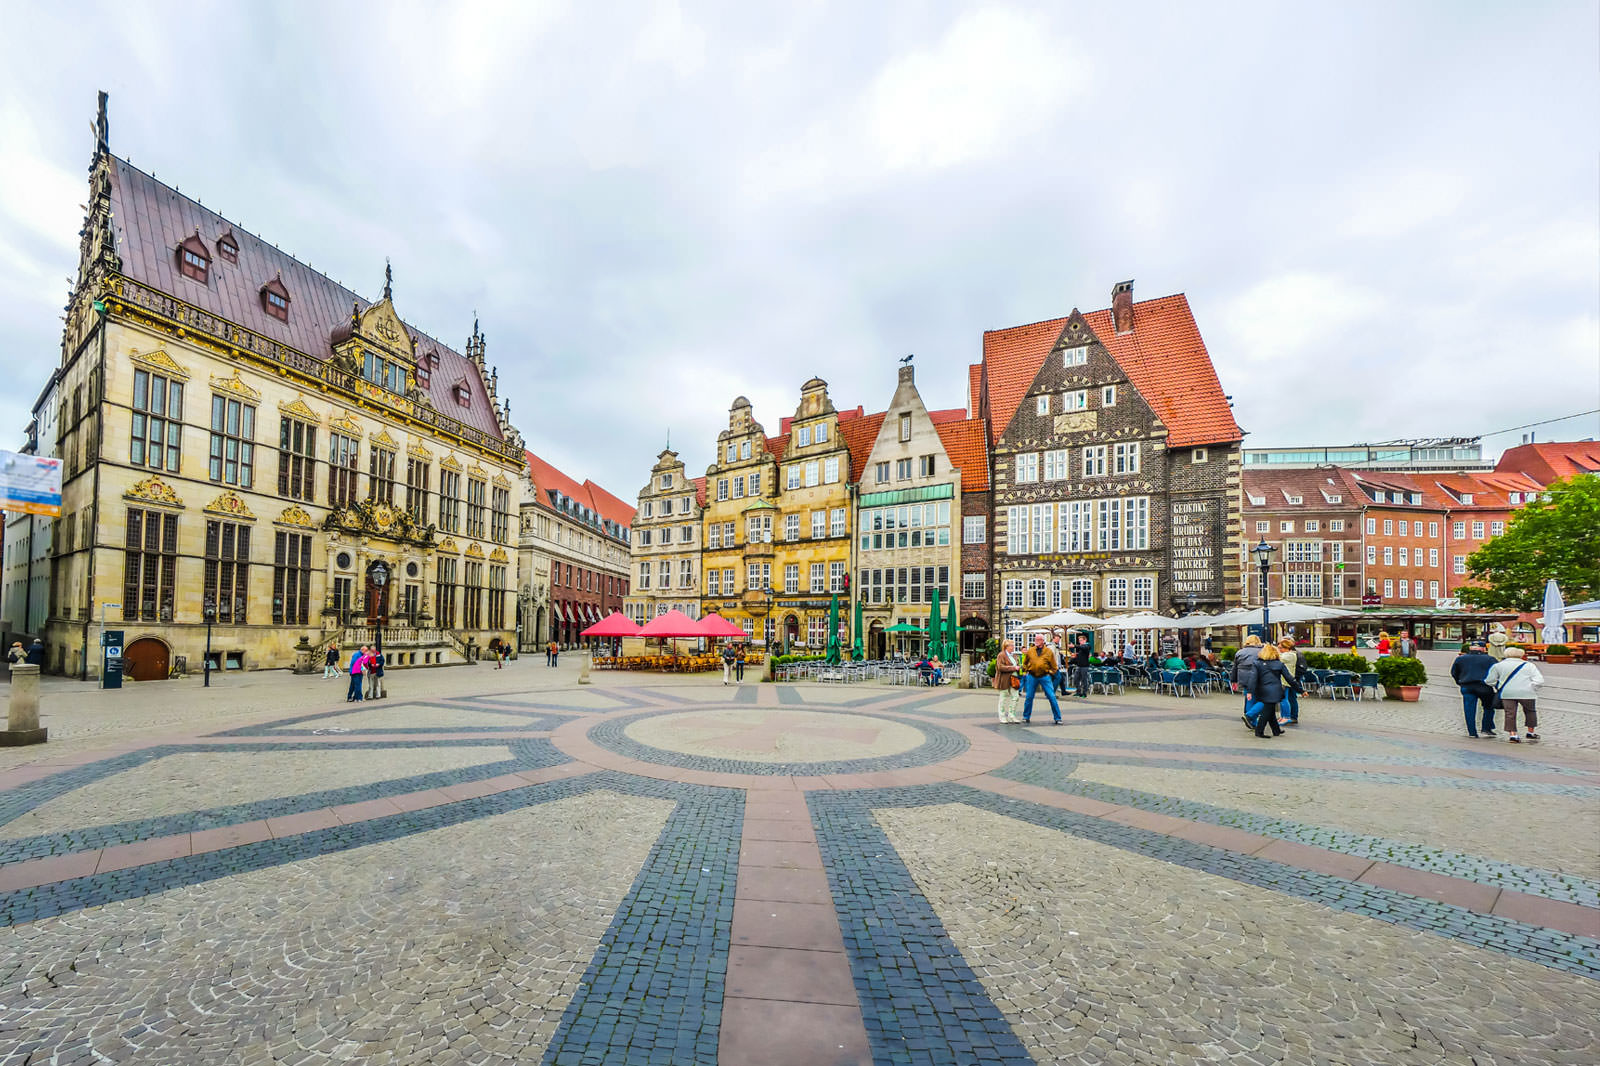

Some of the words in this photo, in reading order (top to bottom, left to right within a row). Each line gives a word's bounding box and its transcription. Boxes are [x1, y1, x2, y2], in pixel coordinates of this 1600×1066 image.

[1173, 515, 1189, 525] DER
[1173, 537, 1185, 547] DIE
[1188, 537, 1202, 547] DAS
[1173, 548, 1213, 558] SCHICKSAL
[1173, 559, 1208, 569] UNSERER
[1173, 570, 1214, 581] TRENNUNG
